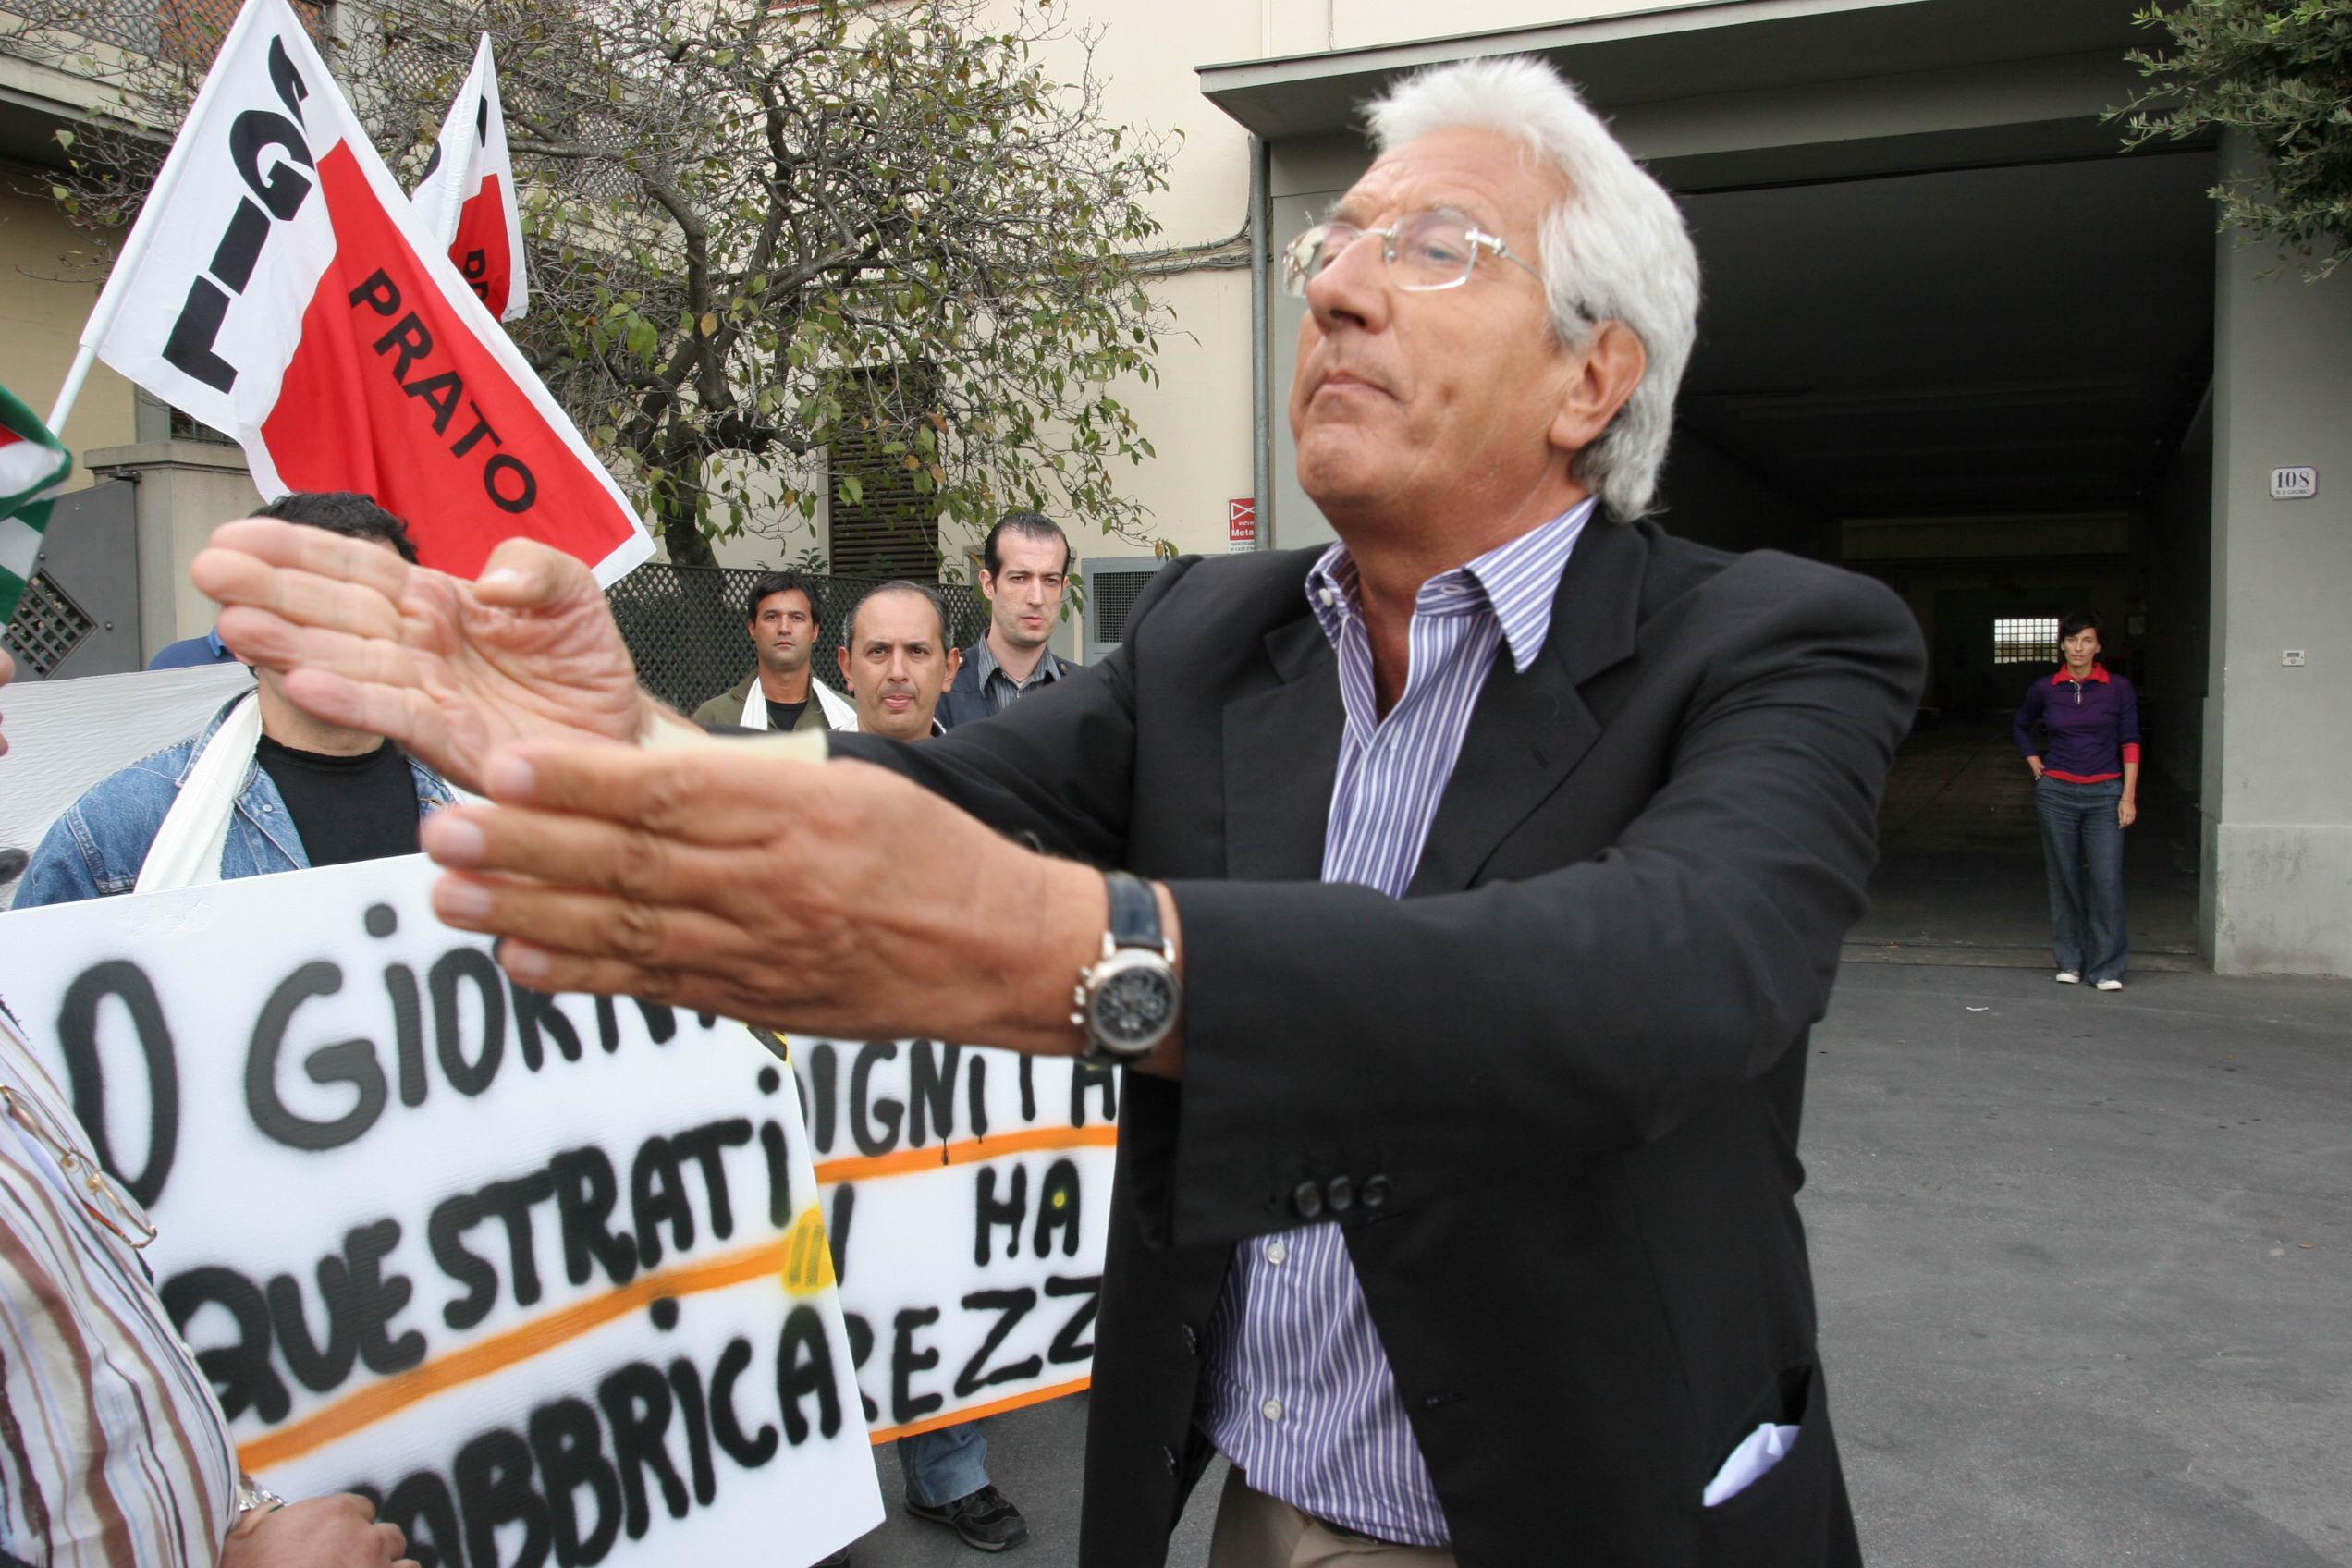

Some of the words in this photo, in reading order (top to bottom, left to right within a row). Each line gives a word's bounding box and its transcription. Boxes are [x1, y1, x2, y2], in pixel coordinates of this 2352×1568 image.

[349, 266, 537, 514] PRATO
[2277, 471, 2309, 489] 108
[793, 1037, 1117, 1158] IGNIA
[974, 1158, 1081, 1268] HA
